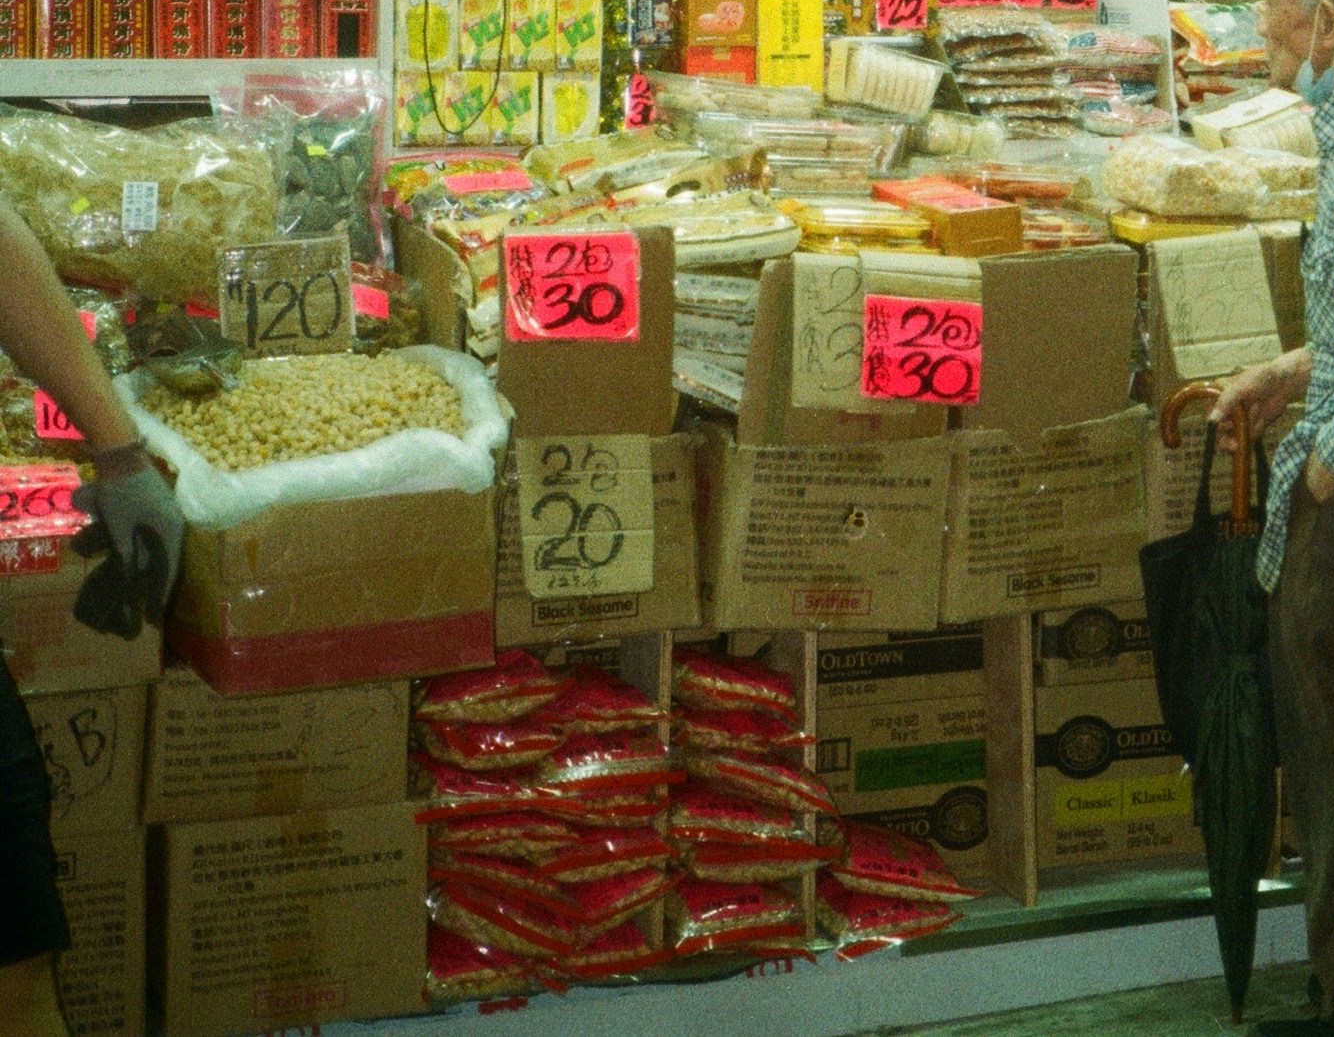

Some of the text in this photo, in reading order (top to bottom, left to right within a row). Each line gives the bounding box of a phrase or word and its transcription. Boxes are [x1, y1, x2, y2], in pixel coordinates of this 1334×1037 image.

[543, 283, 624, 329] 30
[899, 355, 975, 398] 30
[531, 490, 625, 571] 20
[1012, 576, 1045, 592] Black
[538, 604, 576, 622] Black
